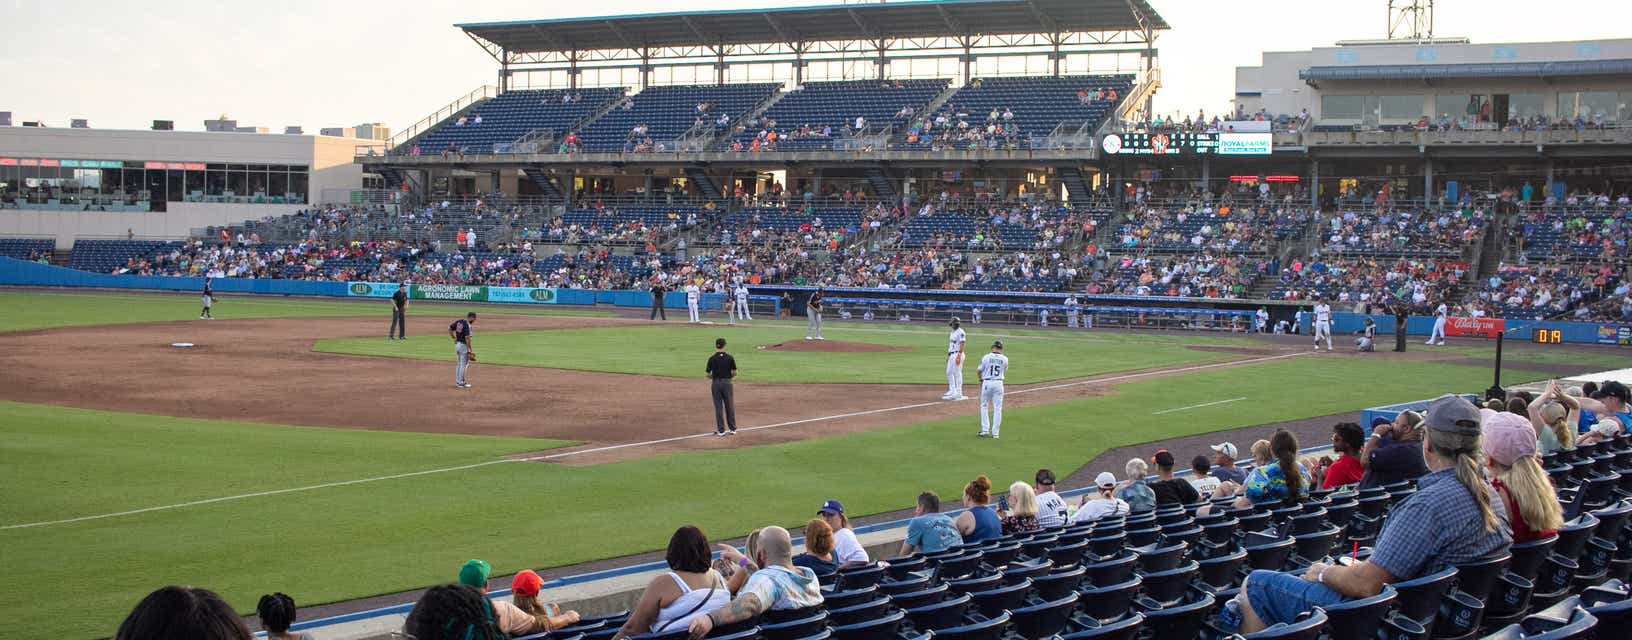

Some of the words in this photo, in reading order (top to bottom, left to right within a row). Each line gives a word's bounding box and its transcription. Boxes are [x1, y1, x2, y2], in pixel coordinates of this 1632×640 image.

[418, 285, 459, 293] AGRONOMIC
[460, 286, 480, 294] LAWN
[425, 292, 472, 300] MANAGEMENT
[536, 290, 549, 300] ALM
[1454, 318, 1482, 331] Bally
[990, 365, 1001, 377] 15
